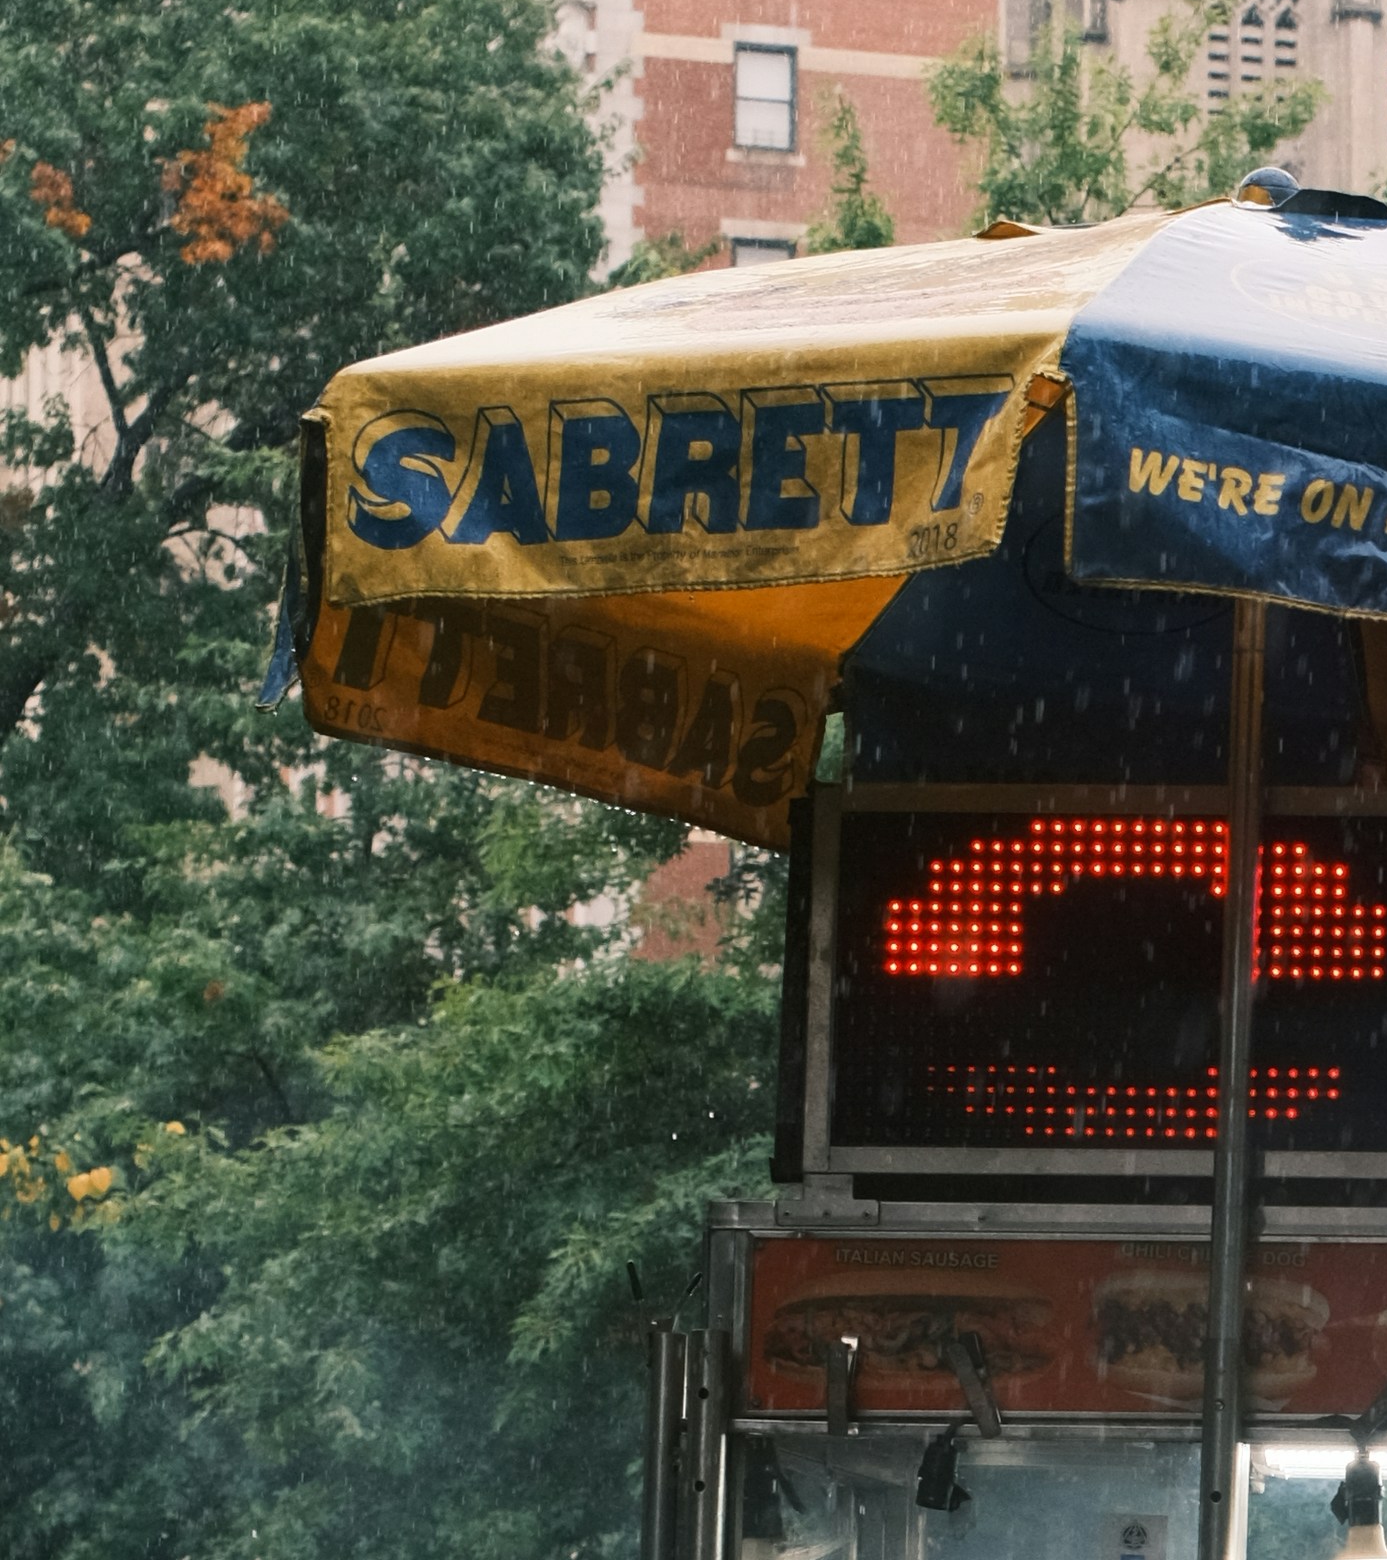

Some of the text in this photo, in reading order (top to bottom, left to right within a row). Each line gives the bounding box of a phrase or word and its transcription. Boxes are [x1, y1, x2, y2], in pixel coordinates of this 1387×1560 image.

[348, 373, 1013, 550] SABRETT
[1128, 446, 1284, 517] WE'RE
[1301, 475, 1374, 534] ON
[908, 521, 958, 558] 2018
[835, 1248, 1000, 1270] ITALIAN SAUSAGE
[1263, 1252, 1306, 1269] DOG
